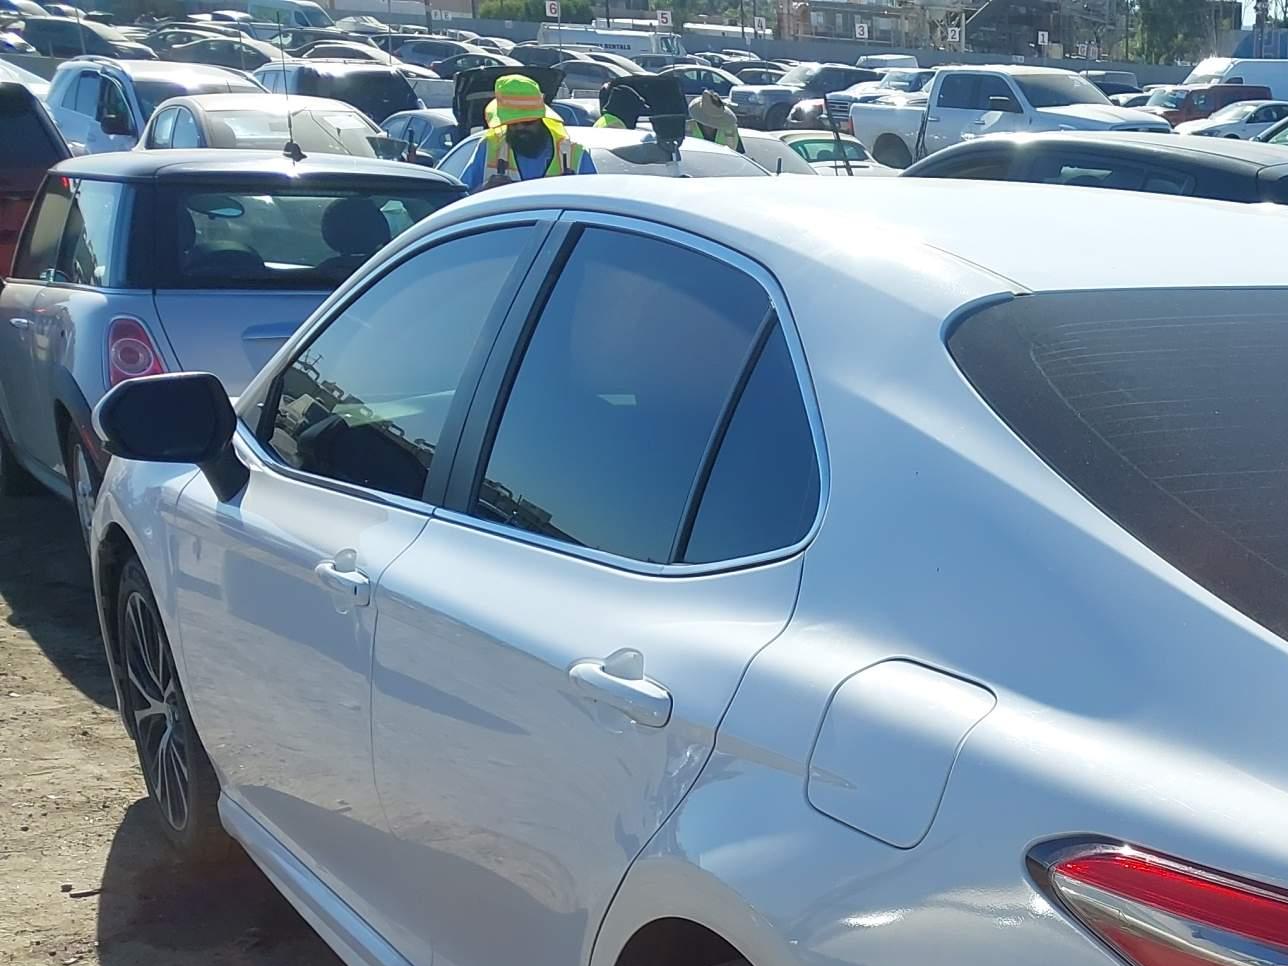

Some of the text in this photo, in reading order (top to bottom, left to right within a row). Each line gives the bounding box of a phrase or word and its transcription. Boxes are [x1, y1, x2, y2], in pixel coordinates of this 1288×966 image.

[549, 2, 558, 15] 6
[660, 12, 669, 24] 5
[757, 18, 764, 29] 4
[857, 25, 866, 36] 3
[950, 29, 957, 39] 2
